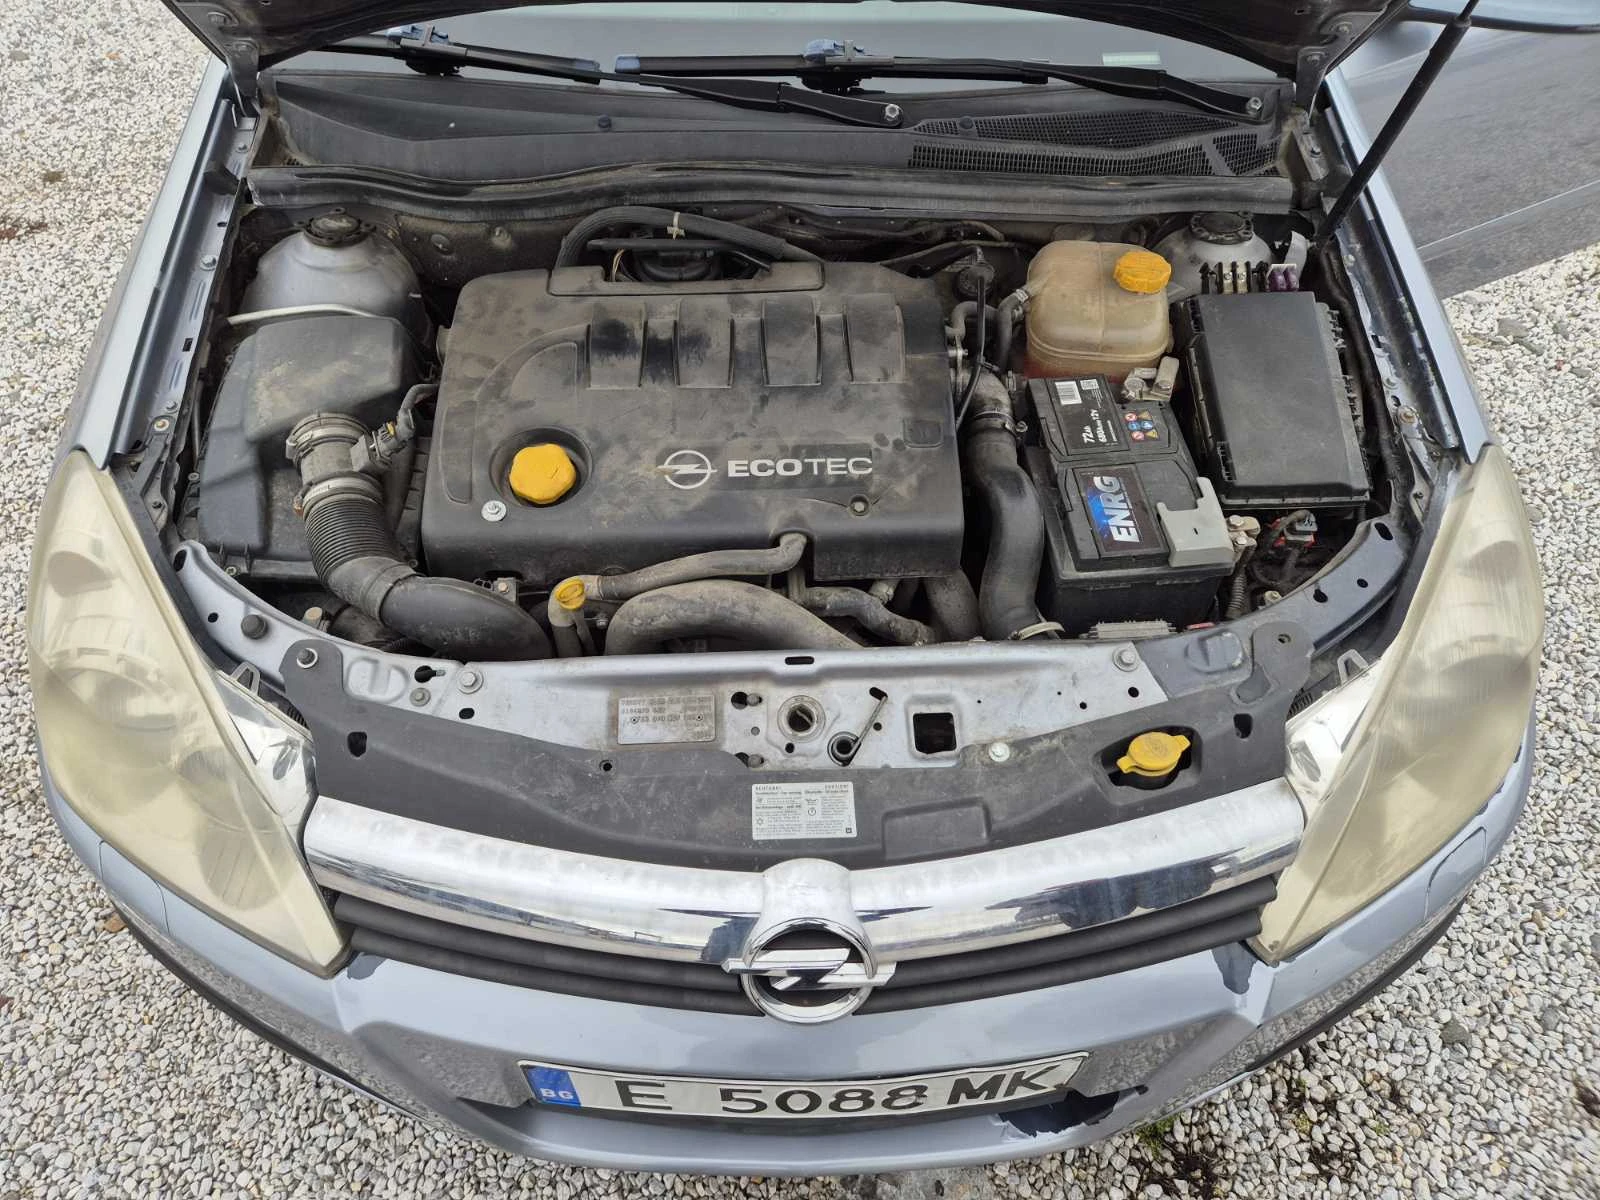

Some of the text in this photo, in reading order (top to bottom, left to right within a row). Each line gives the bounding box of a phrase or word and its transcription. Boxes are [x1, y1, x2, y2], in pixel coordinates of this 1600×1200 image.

[727, 457, 873, 477] ECOTEC
[1093, 476, 1140, 542] ENRG
[540, 1087, 574, 1100] BG
[615, 1065, 1060, 1114] E 5088 MK
